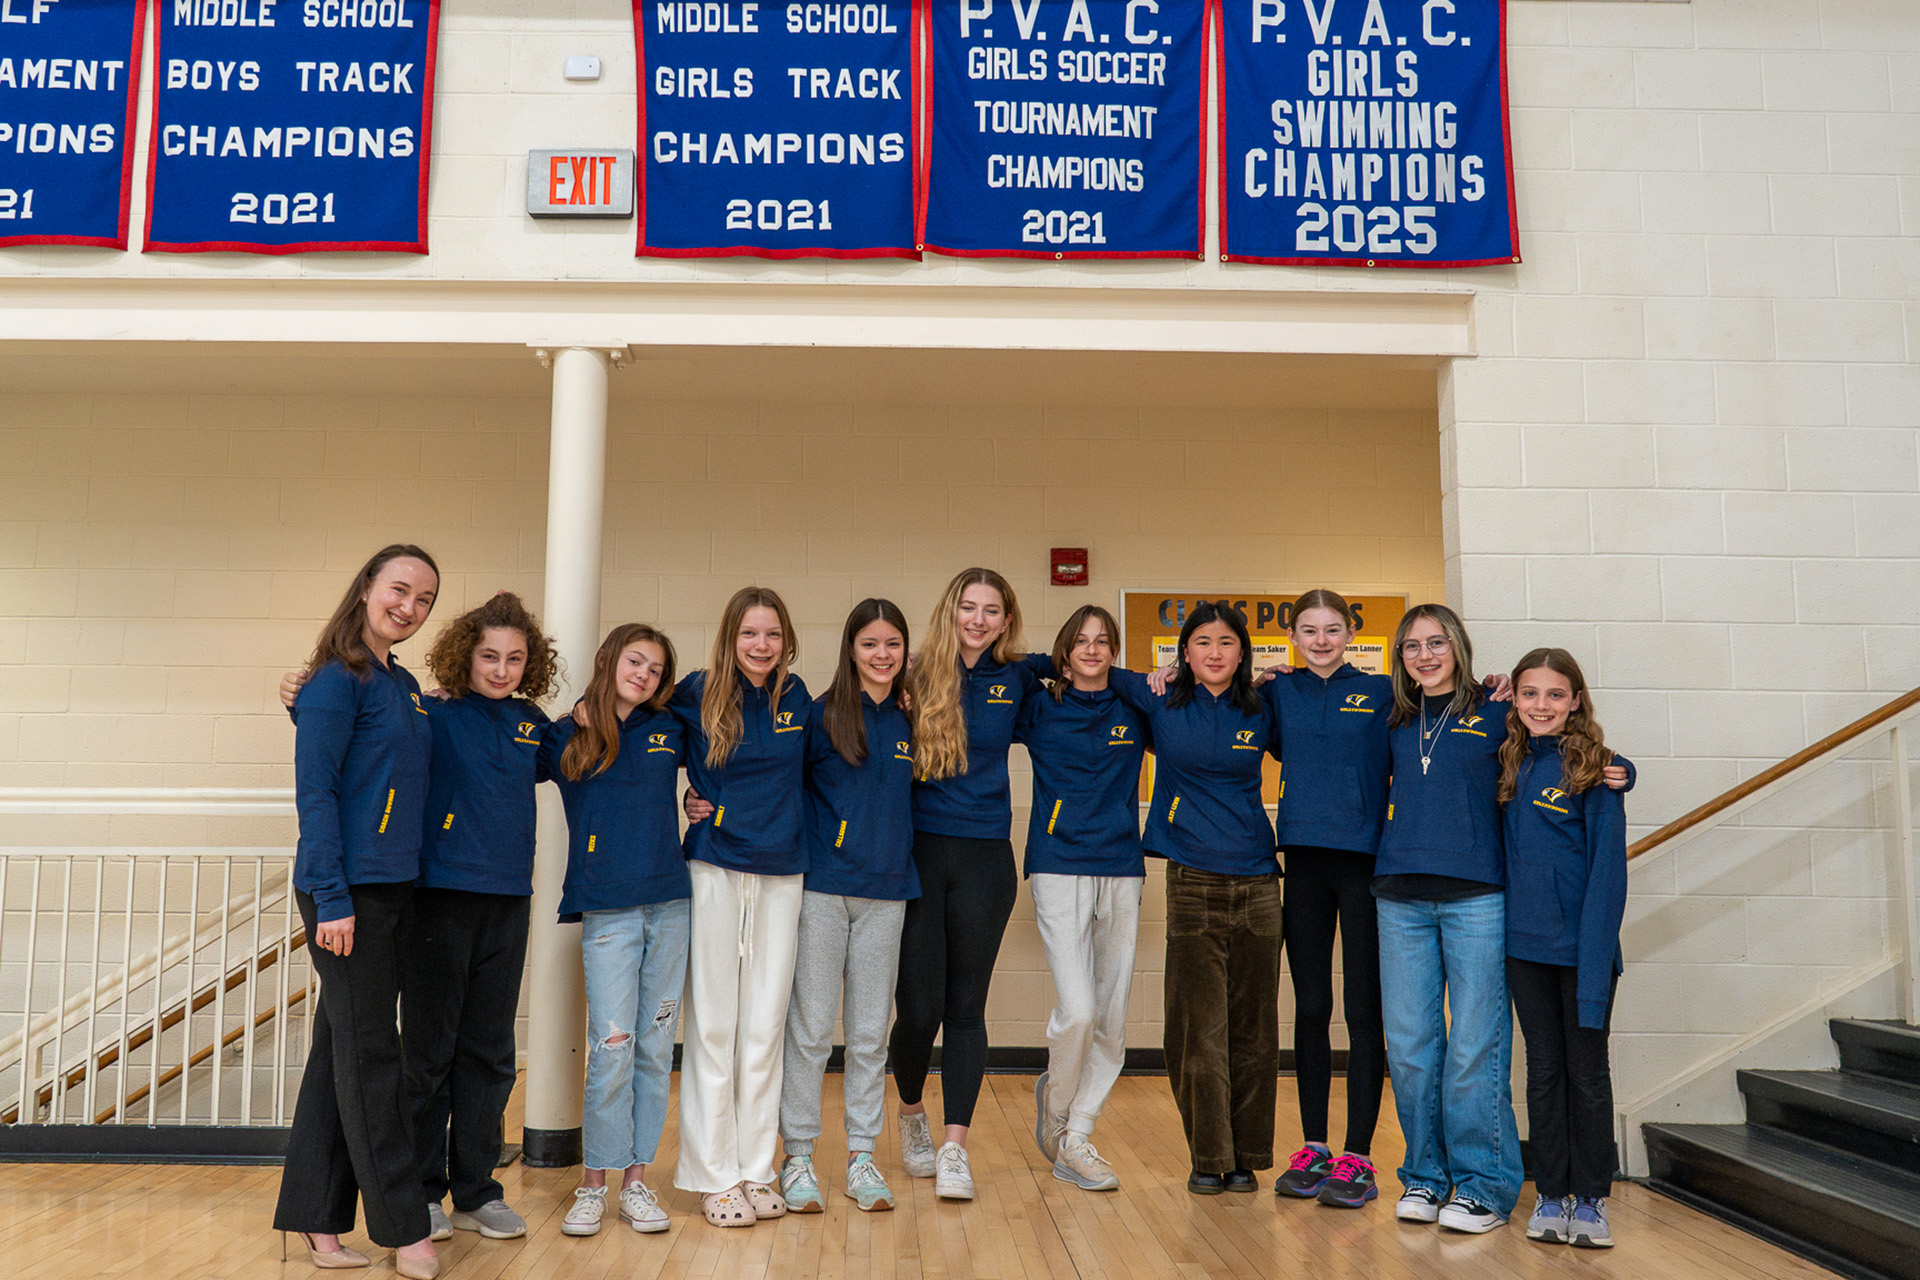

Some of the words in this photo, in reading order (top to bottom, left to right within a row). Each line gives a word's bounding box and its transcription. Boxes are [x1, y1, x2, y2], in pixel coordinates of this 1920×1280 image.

[174, 0, 277, 27] MIDDLE
[303, 0, 414, 28] SCHOOL
[657, 2, 759, 34] MIDDLE
[786, 3, 898, 34] SCHOOL
[167, 59, 261, 92] BOYS
[295, 61, 414, 94] TRACK
[655, 66, 754, 100] GIRLS
[787, 68, 902, 100] TRACK
[967, 46, 1048, 81] GIRLS
[1057, 50, 1166, 87] SOCCER
[1307, 49, 1419, 97] GIRLS
[974, 100, 1158, 140] TOURNAMENT
[1271, 99, 1457, 149] SWIMMING
[163, 124, 415, 159] CHAMPIONS
[653, 131, 905, 166] CHAMPIONS
[549, 156, 617, 205] EXIT
[987, 154, 1144, 192] CHAMPIONS
[1244, 148, 1486, 204] CHAMPIONS
[229, 192, 336, 225] 2021
[726, 199, 832, 231] 2021
[1022, 209, 1107, 244] 2021
[1295, 202, 1438, 254] 2025
